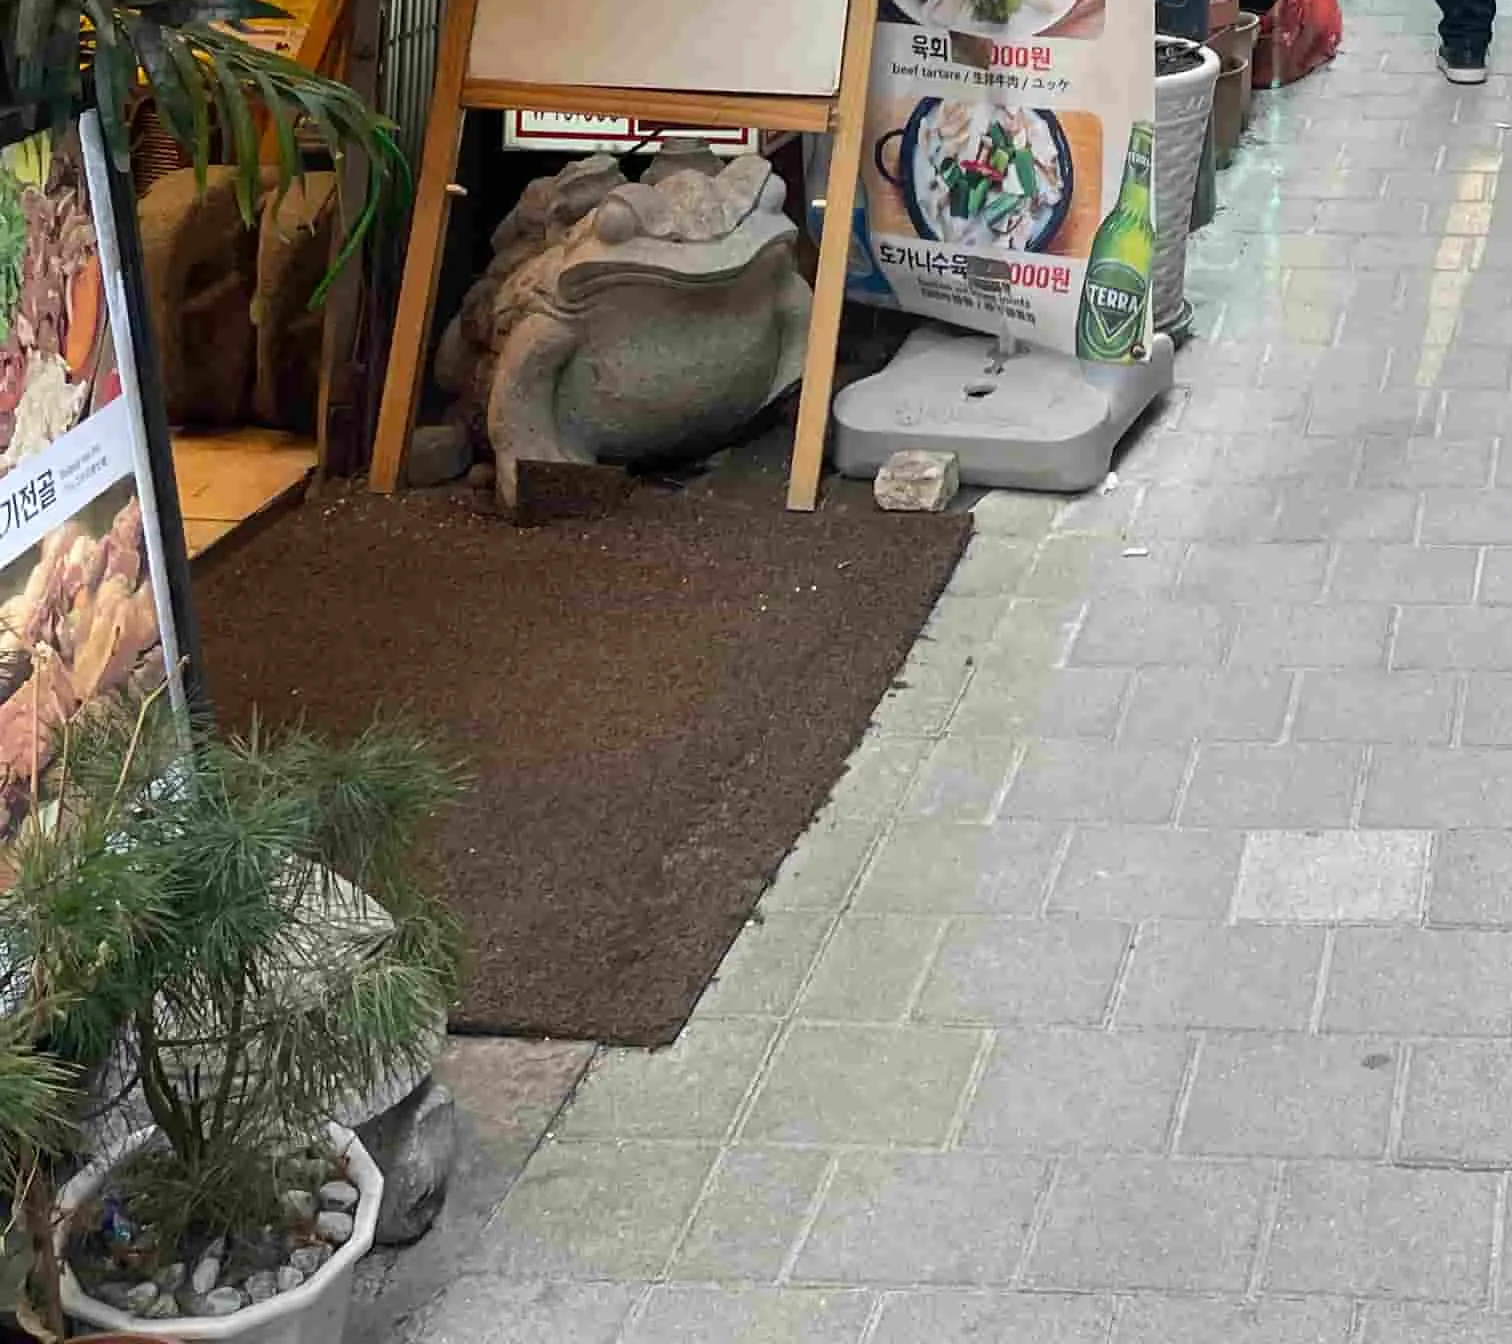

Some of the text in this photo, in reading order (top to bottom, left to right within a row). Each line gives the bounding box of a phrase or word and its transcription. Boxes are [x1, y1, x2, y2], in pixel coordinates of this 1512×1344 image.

[912, 34, 949, 62] 육회
[891, 63, 918, 75] Beef
[880, 244, 968, 279] 도가니수육
[1088, 284, 1138, 311] TERRA
